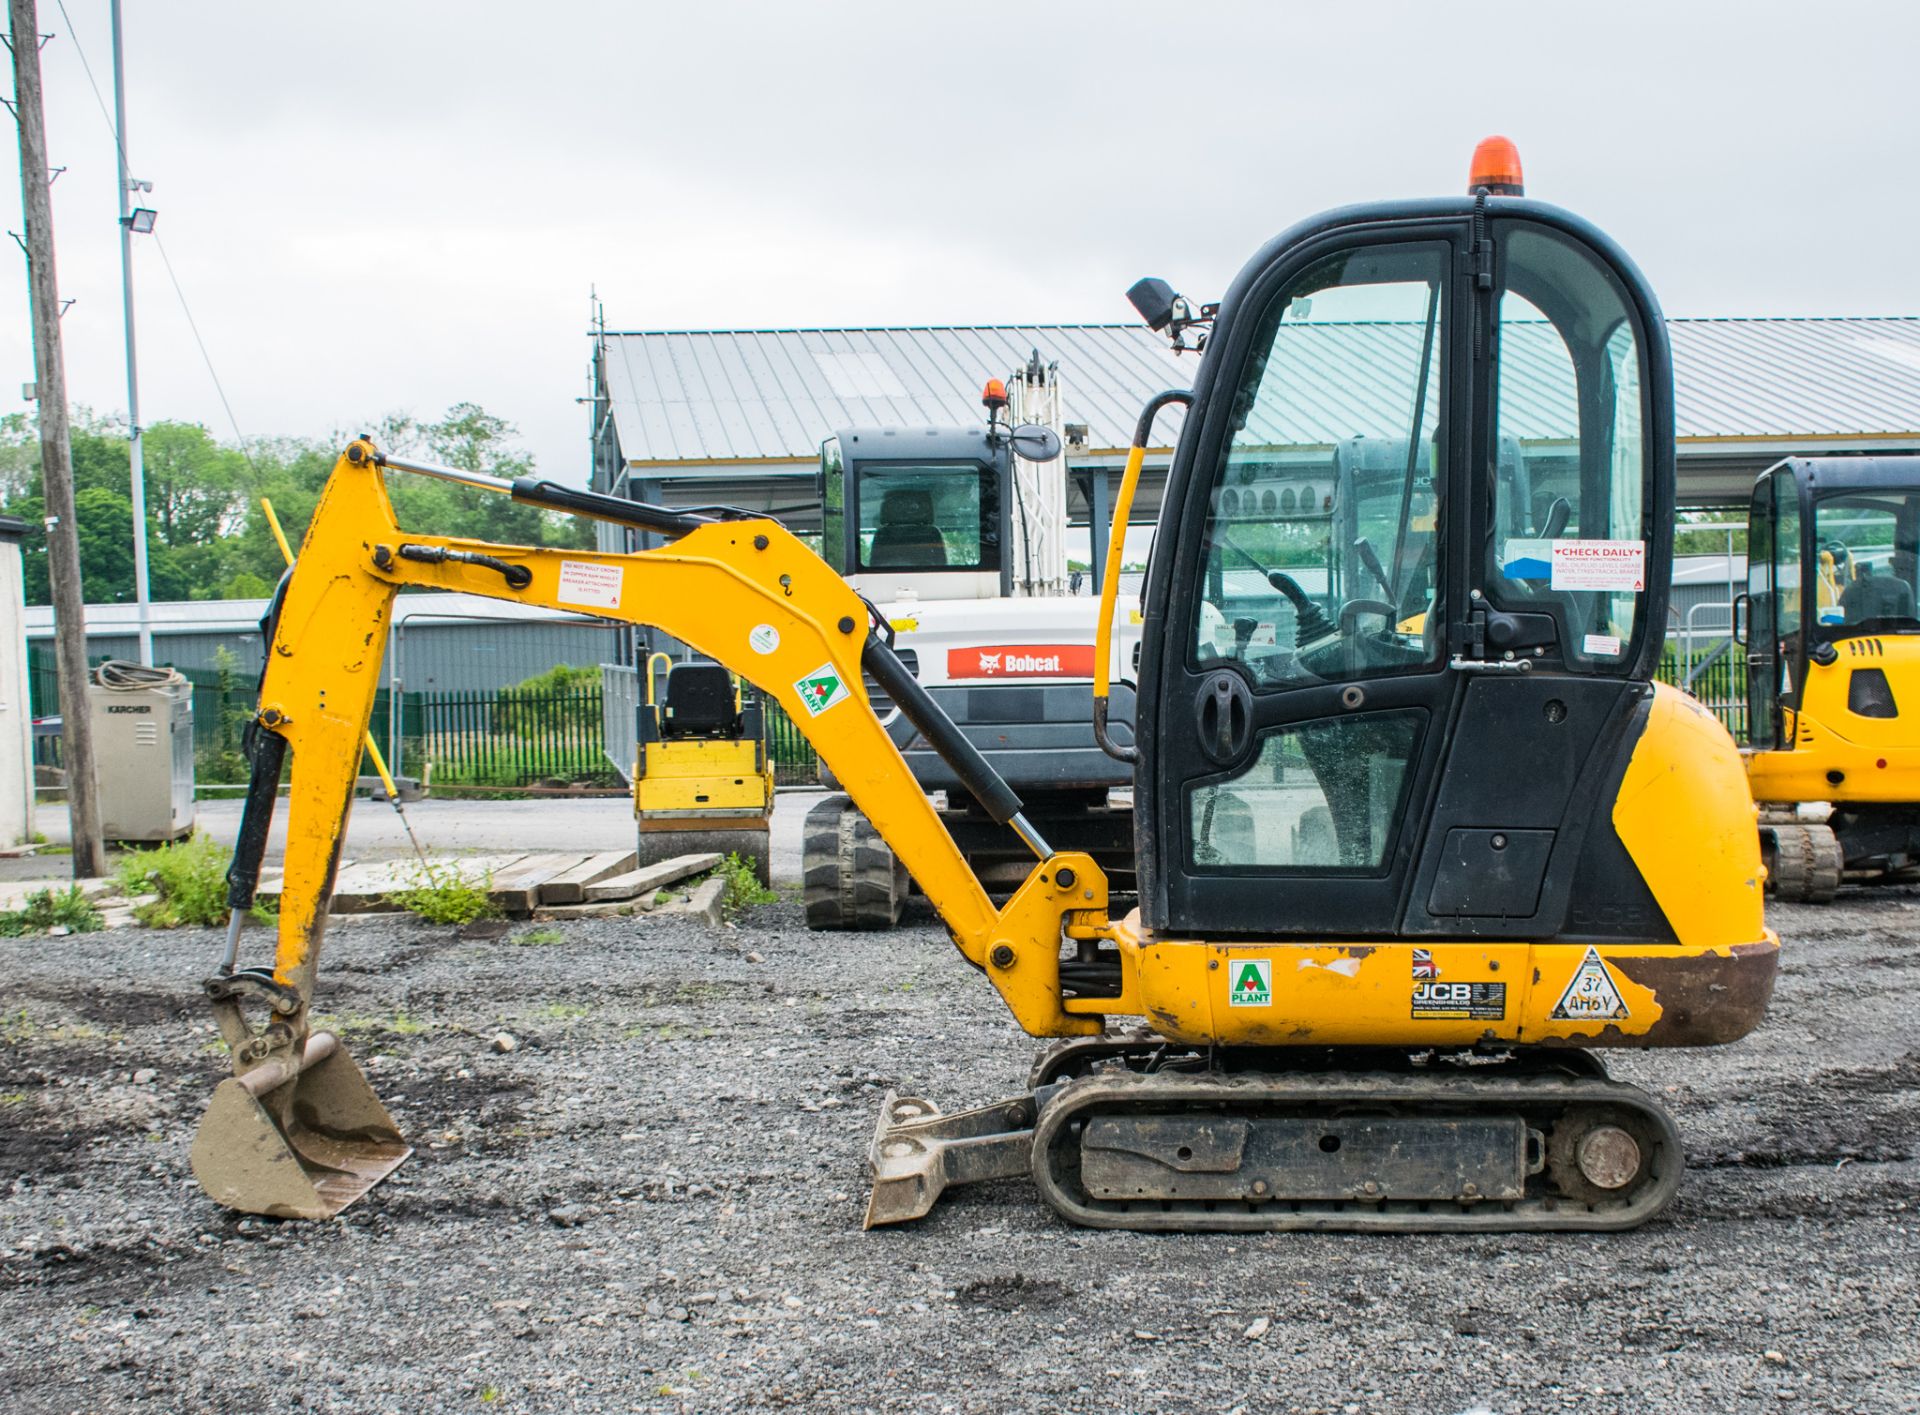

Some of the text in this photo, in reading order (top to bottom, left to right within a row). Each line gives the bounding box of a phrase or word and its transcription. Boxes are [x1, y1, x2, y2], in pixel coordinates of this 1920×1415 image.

[1561, 547, 1634, 557] CHECK DAILY
[1005, 654, 1060, 672] Bobcat
[797, 680, 823, 712] PLANT
[1234, 963, 1267, 992] A
[1231, 993, 1270, 1002] PLANT
[1412, 983, 1472, 1001] JCB
